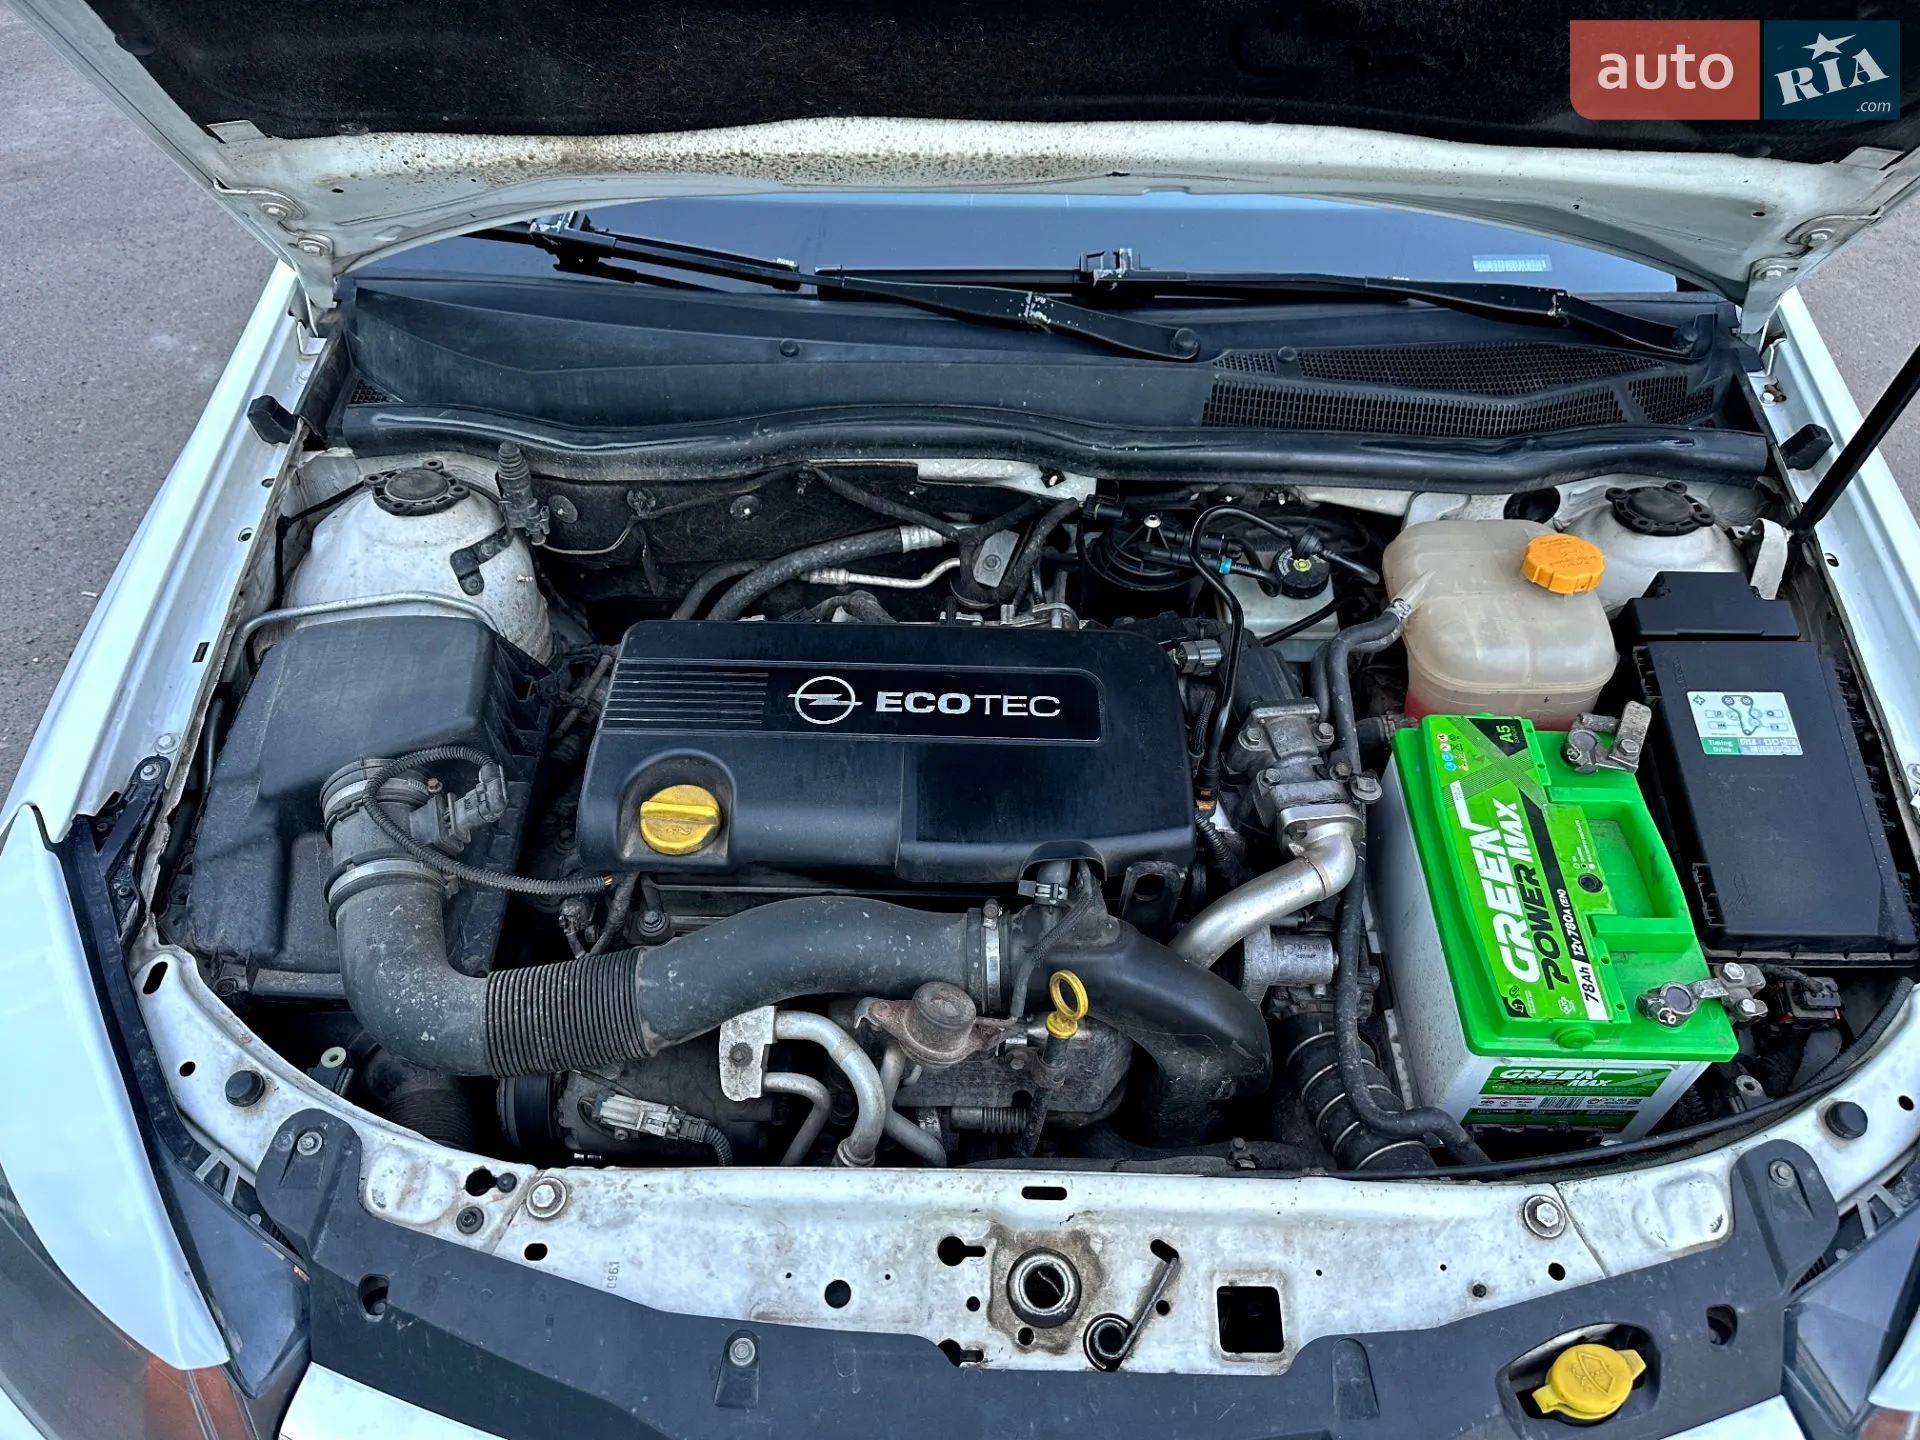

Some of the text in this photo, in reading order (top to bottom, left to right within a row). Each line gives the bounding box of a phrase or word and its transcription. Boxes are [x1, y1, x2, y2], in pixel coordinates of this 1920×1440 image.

[876, 691, 1061, 717] ECOTEC
[1496, 725, 1514, 744] A5
[1492, 798, 1534, 863] MAX
[1449, 780, 1540, 983] GREEN
[1513, 863, 1570, 991] POWER
[1578, 966, 1600, 1004] 78Ah
[1496, 1079, 1611, 1087] POWER MAX
[1499, 1069, 1638, 1081] GREEN
